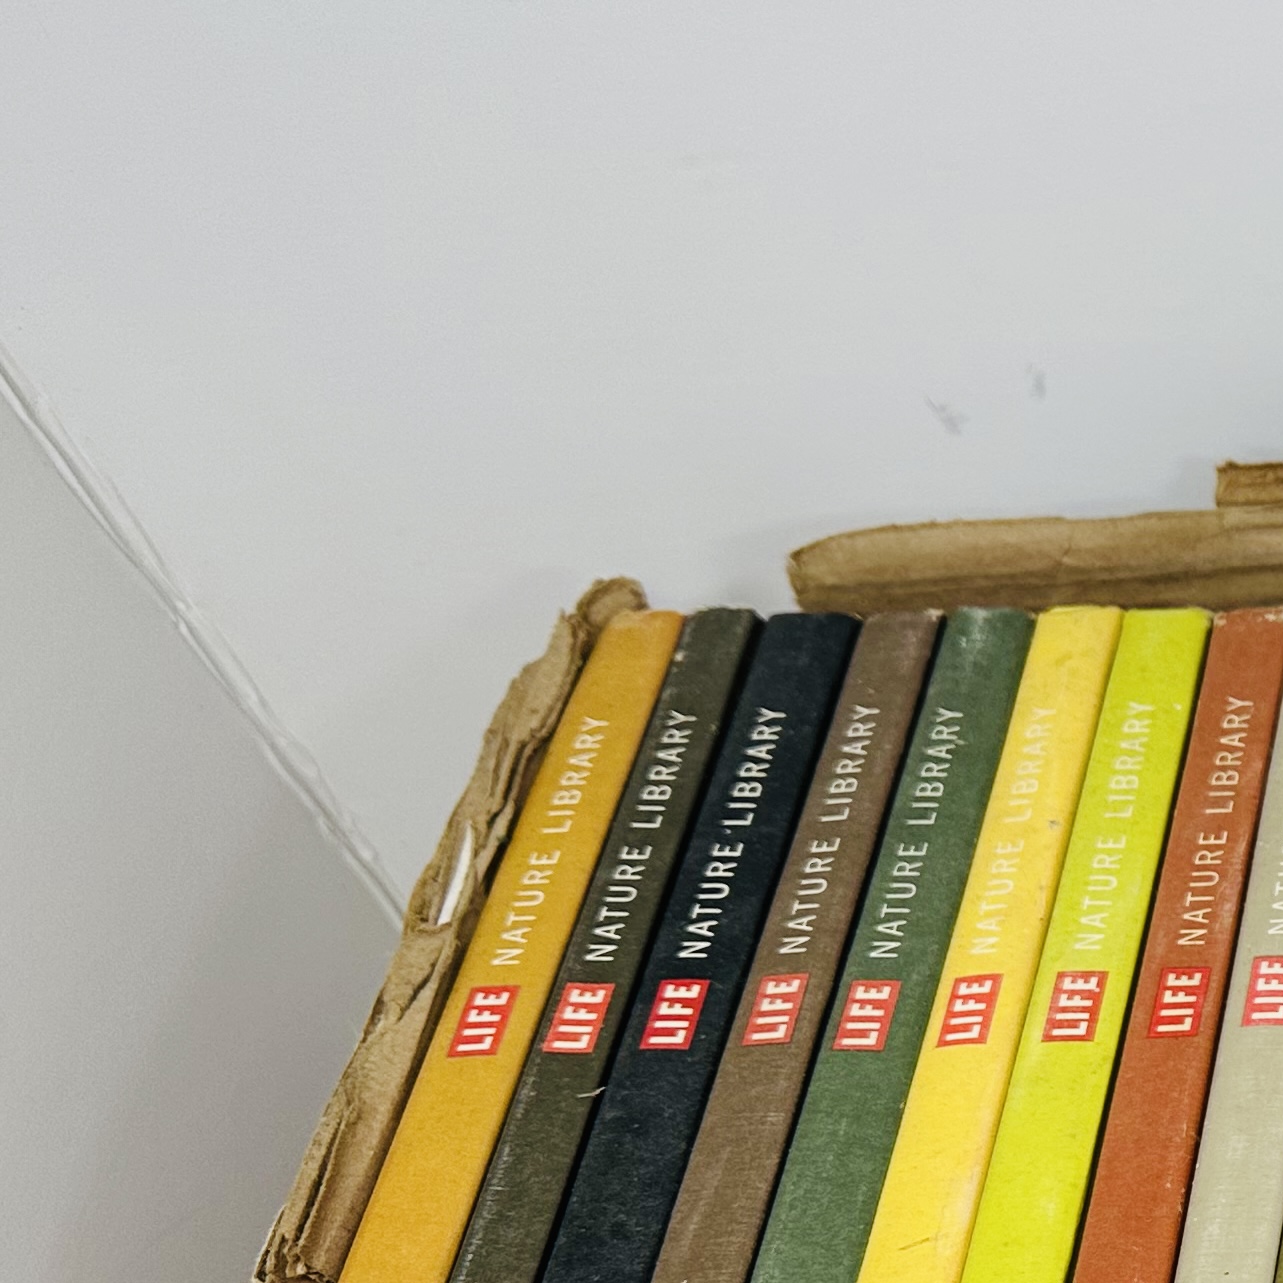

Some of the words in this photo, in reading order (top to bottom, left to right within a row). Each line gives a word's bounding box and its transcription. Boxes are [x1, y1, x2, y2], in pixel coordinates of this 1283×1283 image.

[1102, 701, 1156, 820] LIBRARY
[1206, 697, 1254, 814] LIBRARY
[458, 989, 511, 1052] LIFE
[492, 849, 559, 966] NATURE
[542, 716, 609, 834] LIBRARY
[552, 986, 610, 1049] LIFE
[585, 845, 651, 962] NATURE
[632, 710, 698, 828] LIBRARY
[649, 980, 702, 1046] LIFE
[679, 841, 743, 959] NATURE
[727, 707, 788, 826] LIBRARY
[752, 977, 801, 1041] LIFE
[779, 839, 840, 954] NATURE
[819, 704, 880, 820] LIBRARY
[843, 982, 892, 1046] LIFE
[870, 842, 928, 958] NATURE
[911, 708, 964, 825] LIBRARY
[945, 978, 994, 1041] LIFE
[971, 841, 1024, 954] NATURE
[1006, 706, 1057, 822] LIBRARY
[1074, 834, 1126, 950] NATURE
[1178, 829, 1229, 946] NATURE
[1051, 975, 1099, 1038] LIFE
[1158, 971, 1201, 1033] LIFE
